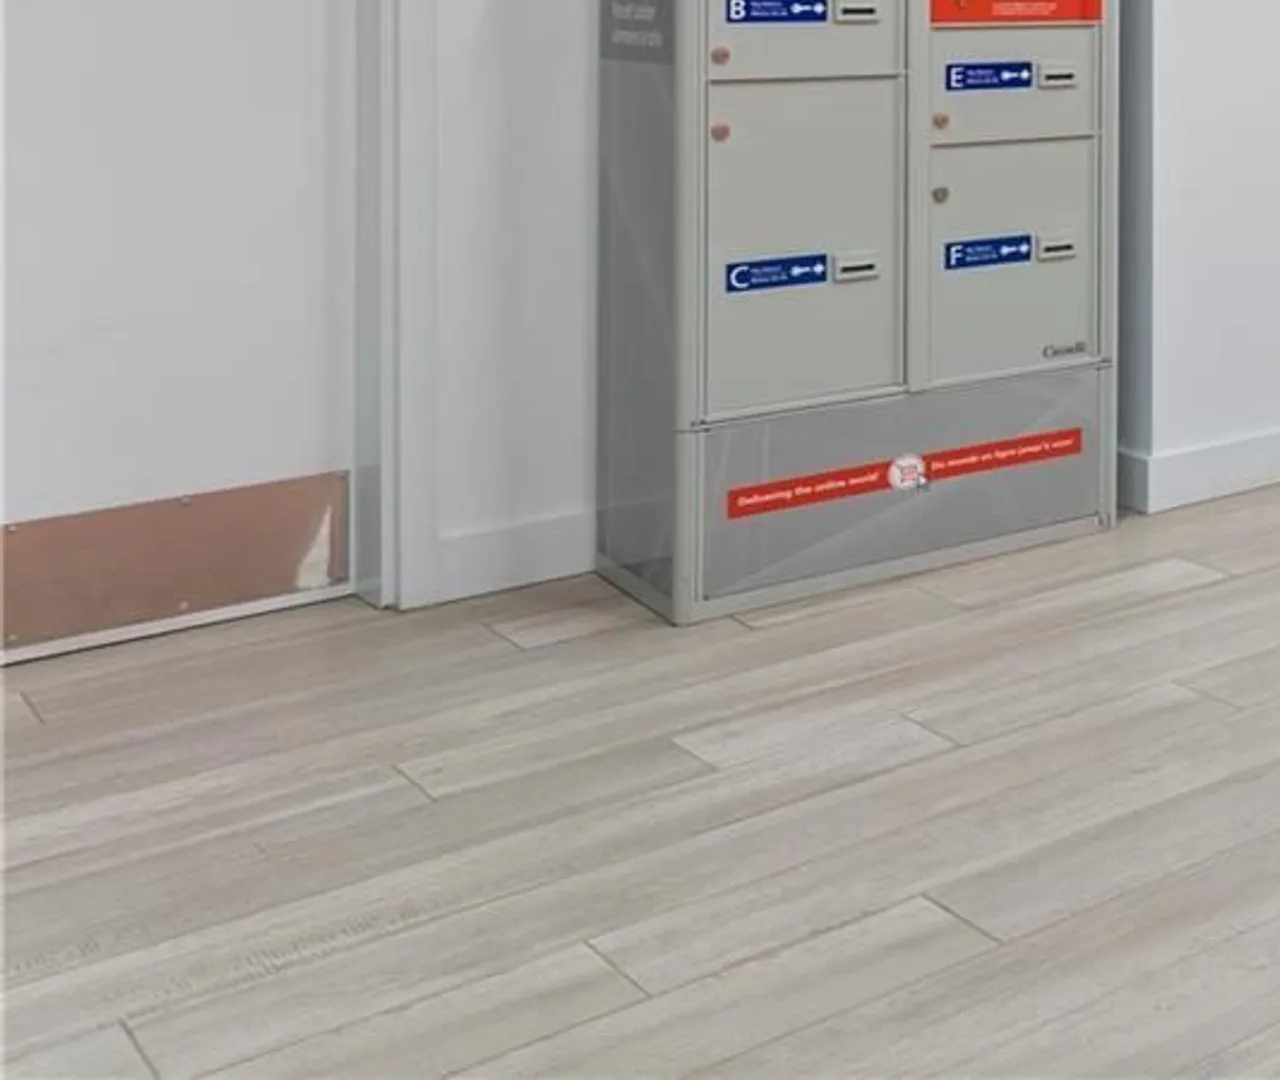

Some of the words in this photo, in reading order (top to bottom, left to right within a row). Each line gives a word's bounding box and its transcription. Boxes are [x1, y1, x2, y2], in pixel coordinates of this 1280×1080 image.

[950, 67, 965, 88] E
[950, 245, 964, 266] F
[729, 265, 750, 289] C
